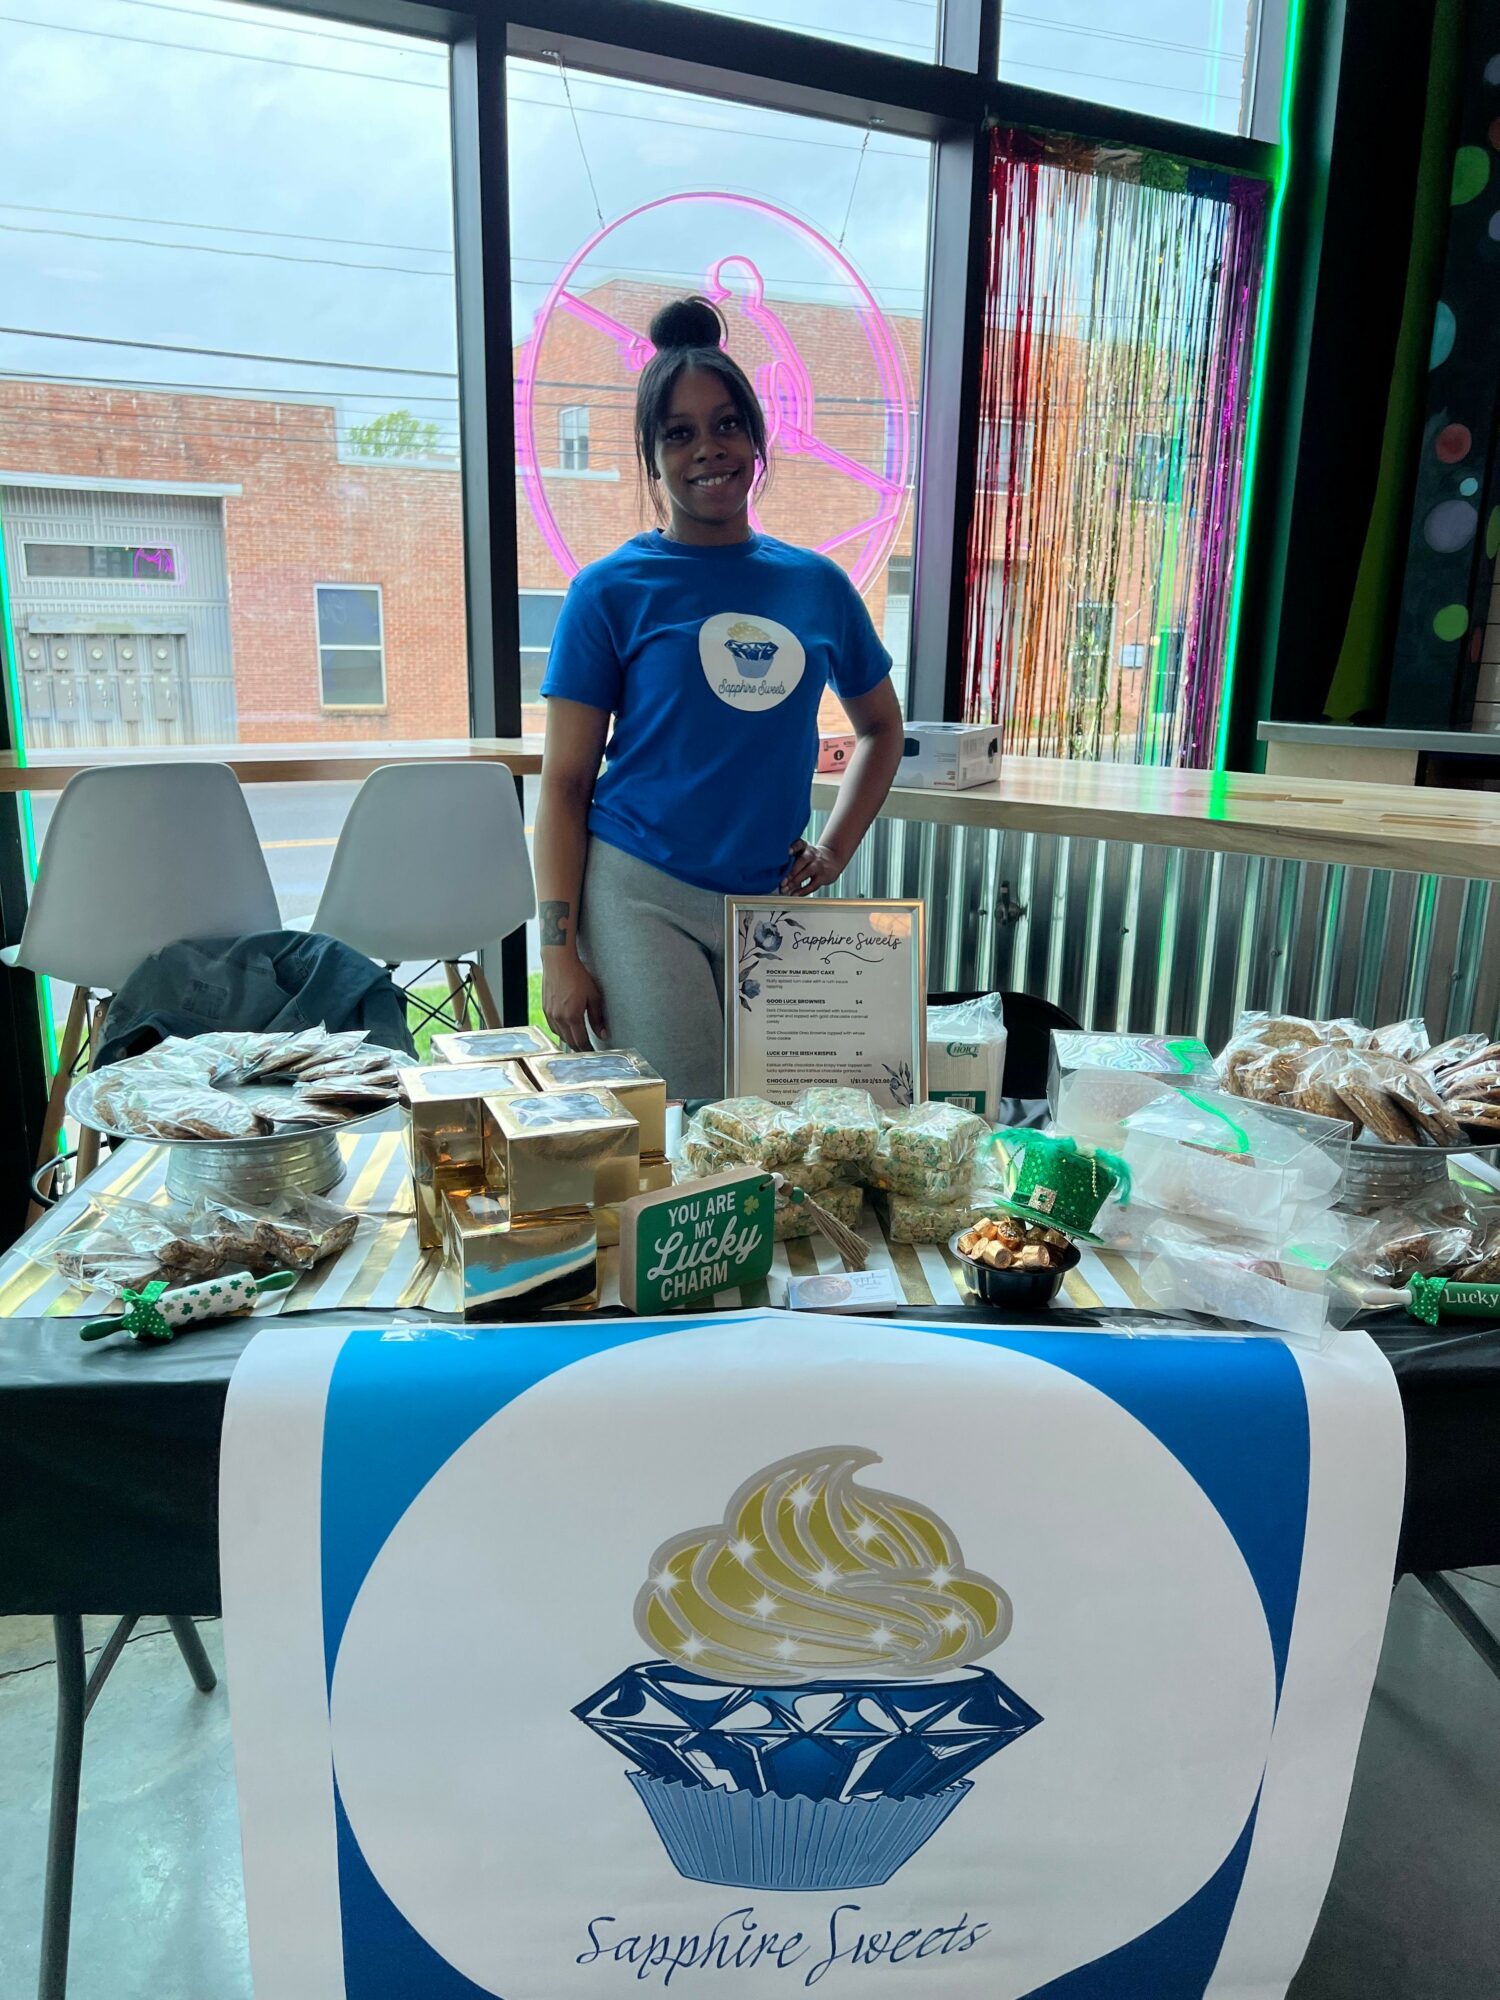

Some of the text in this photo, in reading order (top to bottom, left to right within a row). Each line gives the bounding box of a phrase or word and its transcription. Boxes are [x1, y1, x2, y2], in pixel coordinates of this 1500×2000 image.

[718, 679, 786, 697] Sapphire Sweets
[792, 930, 902, 951] Sapphire Sweets
[946, 1042, 979, 1058] CHOICE
[668, 1191, 736, 1227] YOU ARE
[694, 1218, 715, 1240] MY
[646, 1215, 763, 1281] Lucky
[660, 1260, 728, 1301] CHARM
[1443, 1287, 1499, 1308] Lucky
[576, 1904, 992, 1986] Sapphire Sweets
